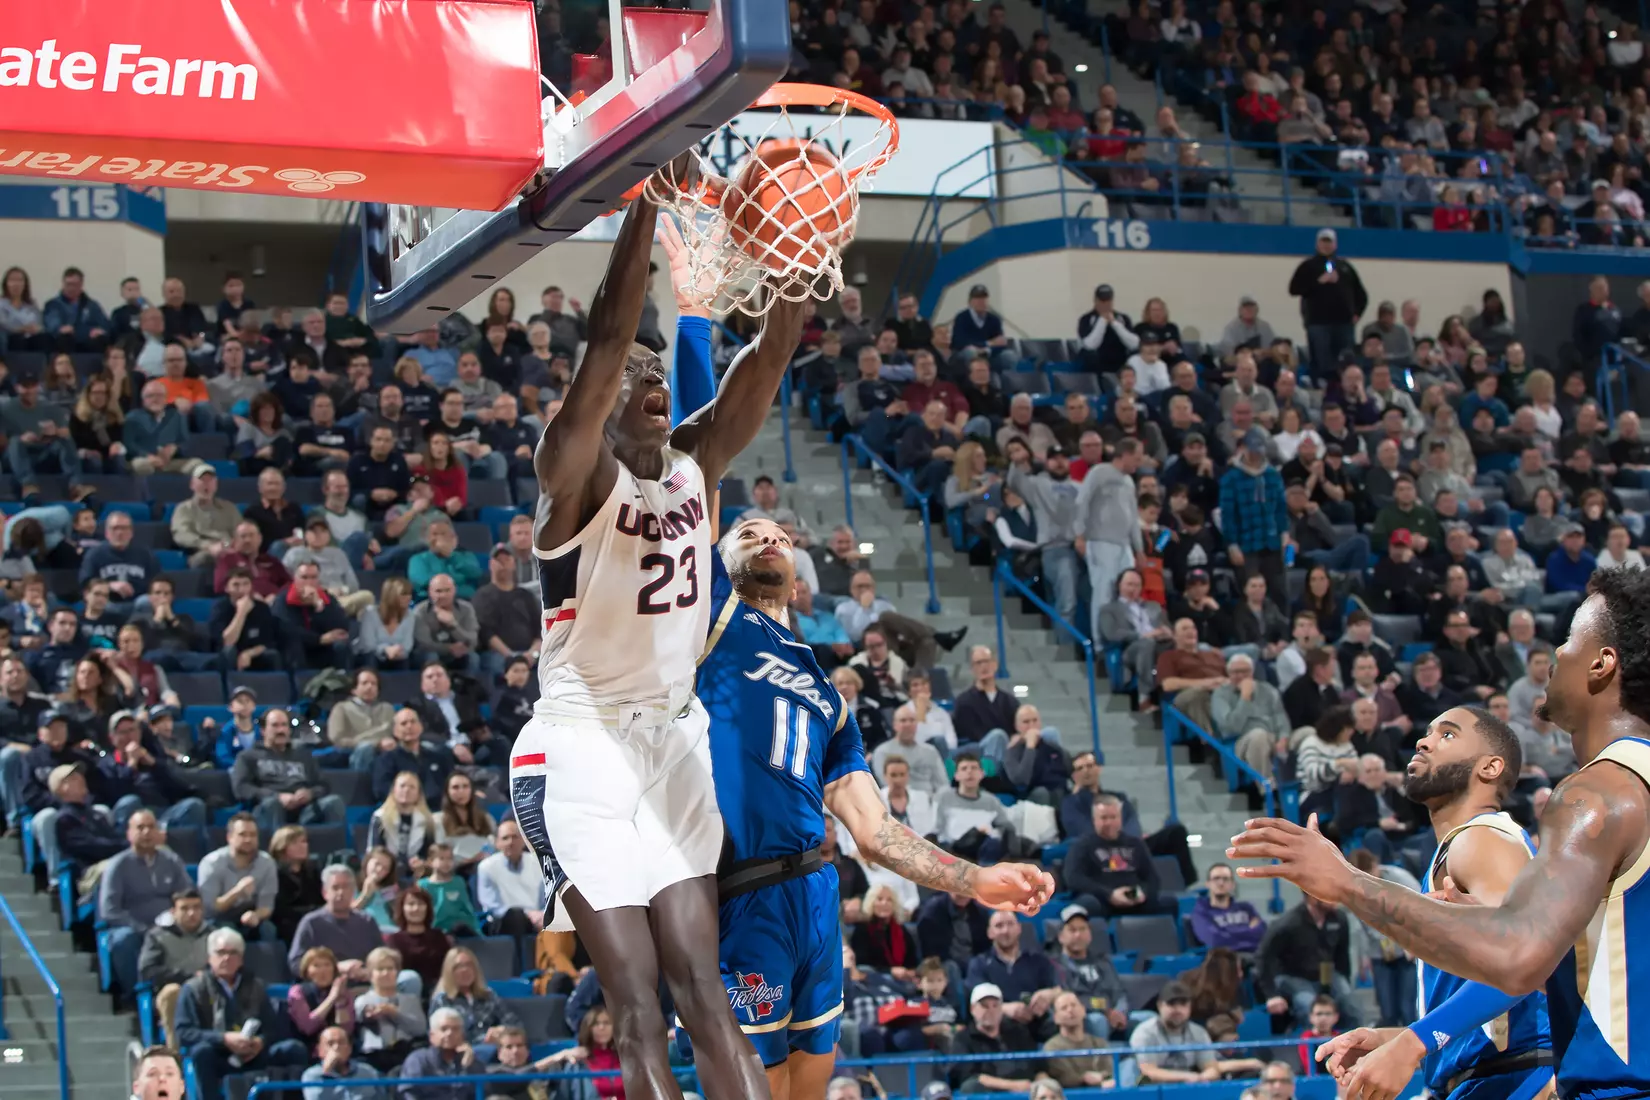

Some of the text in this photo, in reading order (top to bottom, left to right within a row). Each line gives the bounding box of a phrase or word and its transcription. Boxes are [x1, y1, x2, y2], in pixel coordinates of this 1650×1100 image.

[103, 43, 258, 101] Farm
[0, 149, 270, 187] State Far
[50, 186, 120, 220] 115
[1091, 219, 1151, 250] 116
[615, 492, 704, 542] UCONN
[637, 545, 699, 615] 23
[743, 651, 834, 720] Tulsa
[770, 696, 811, 780] 11
[727, 981, 784, 1010] Tulsa
